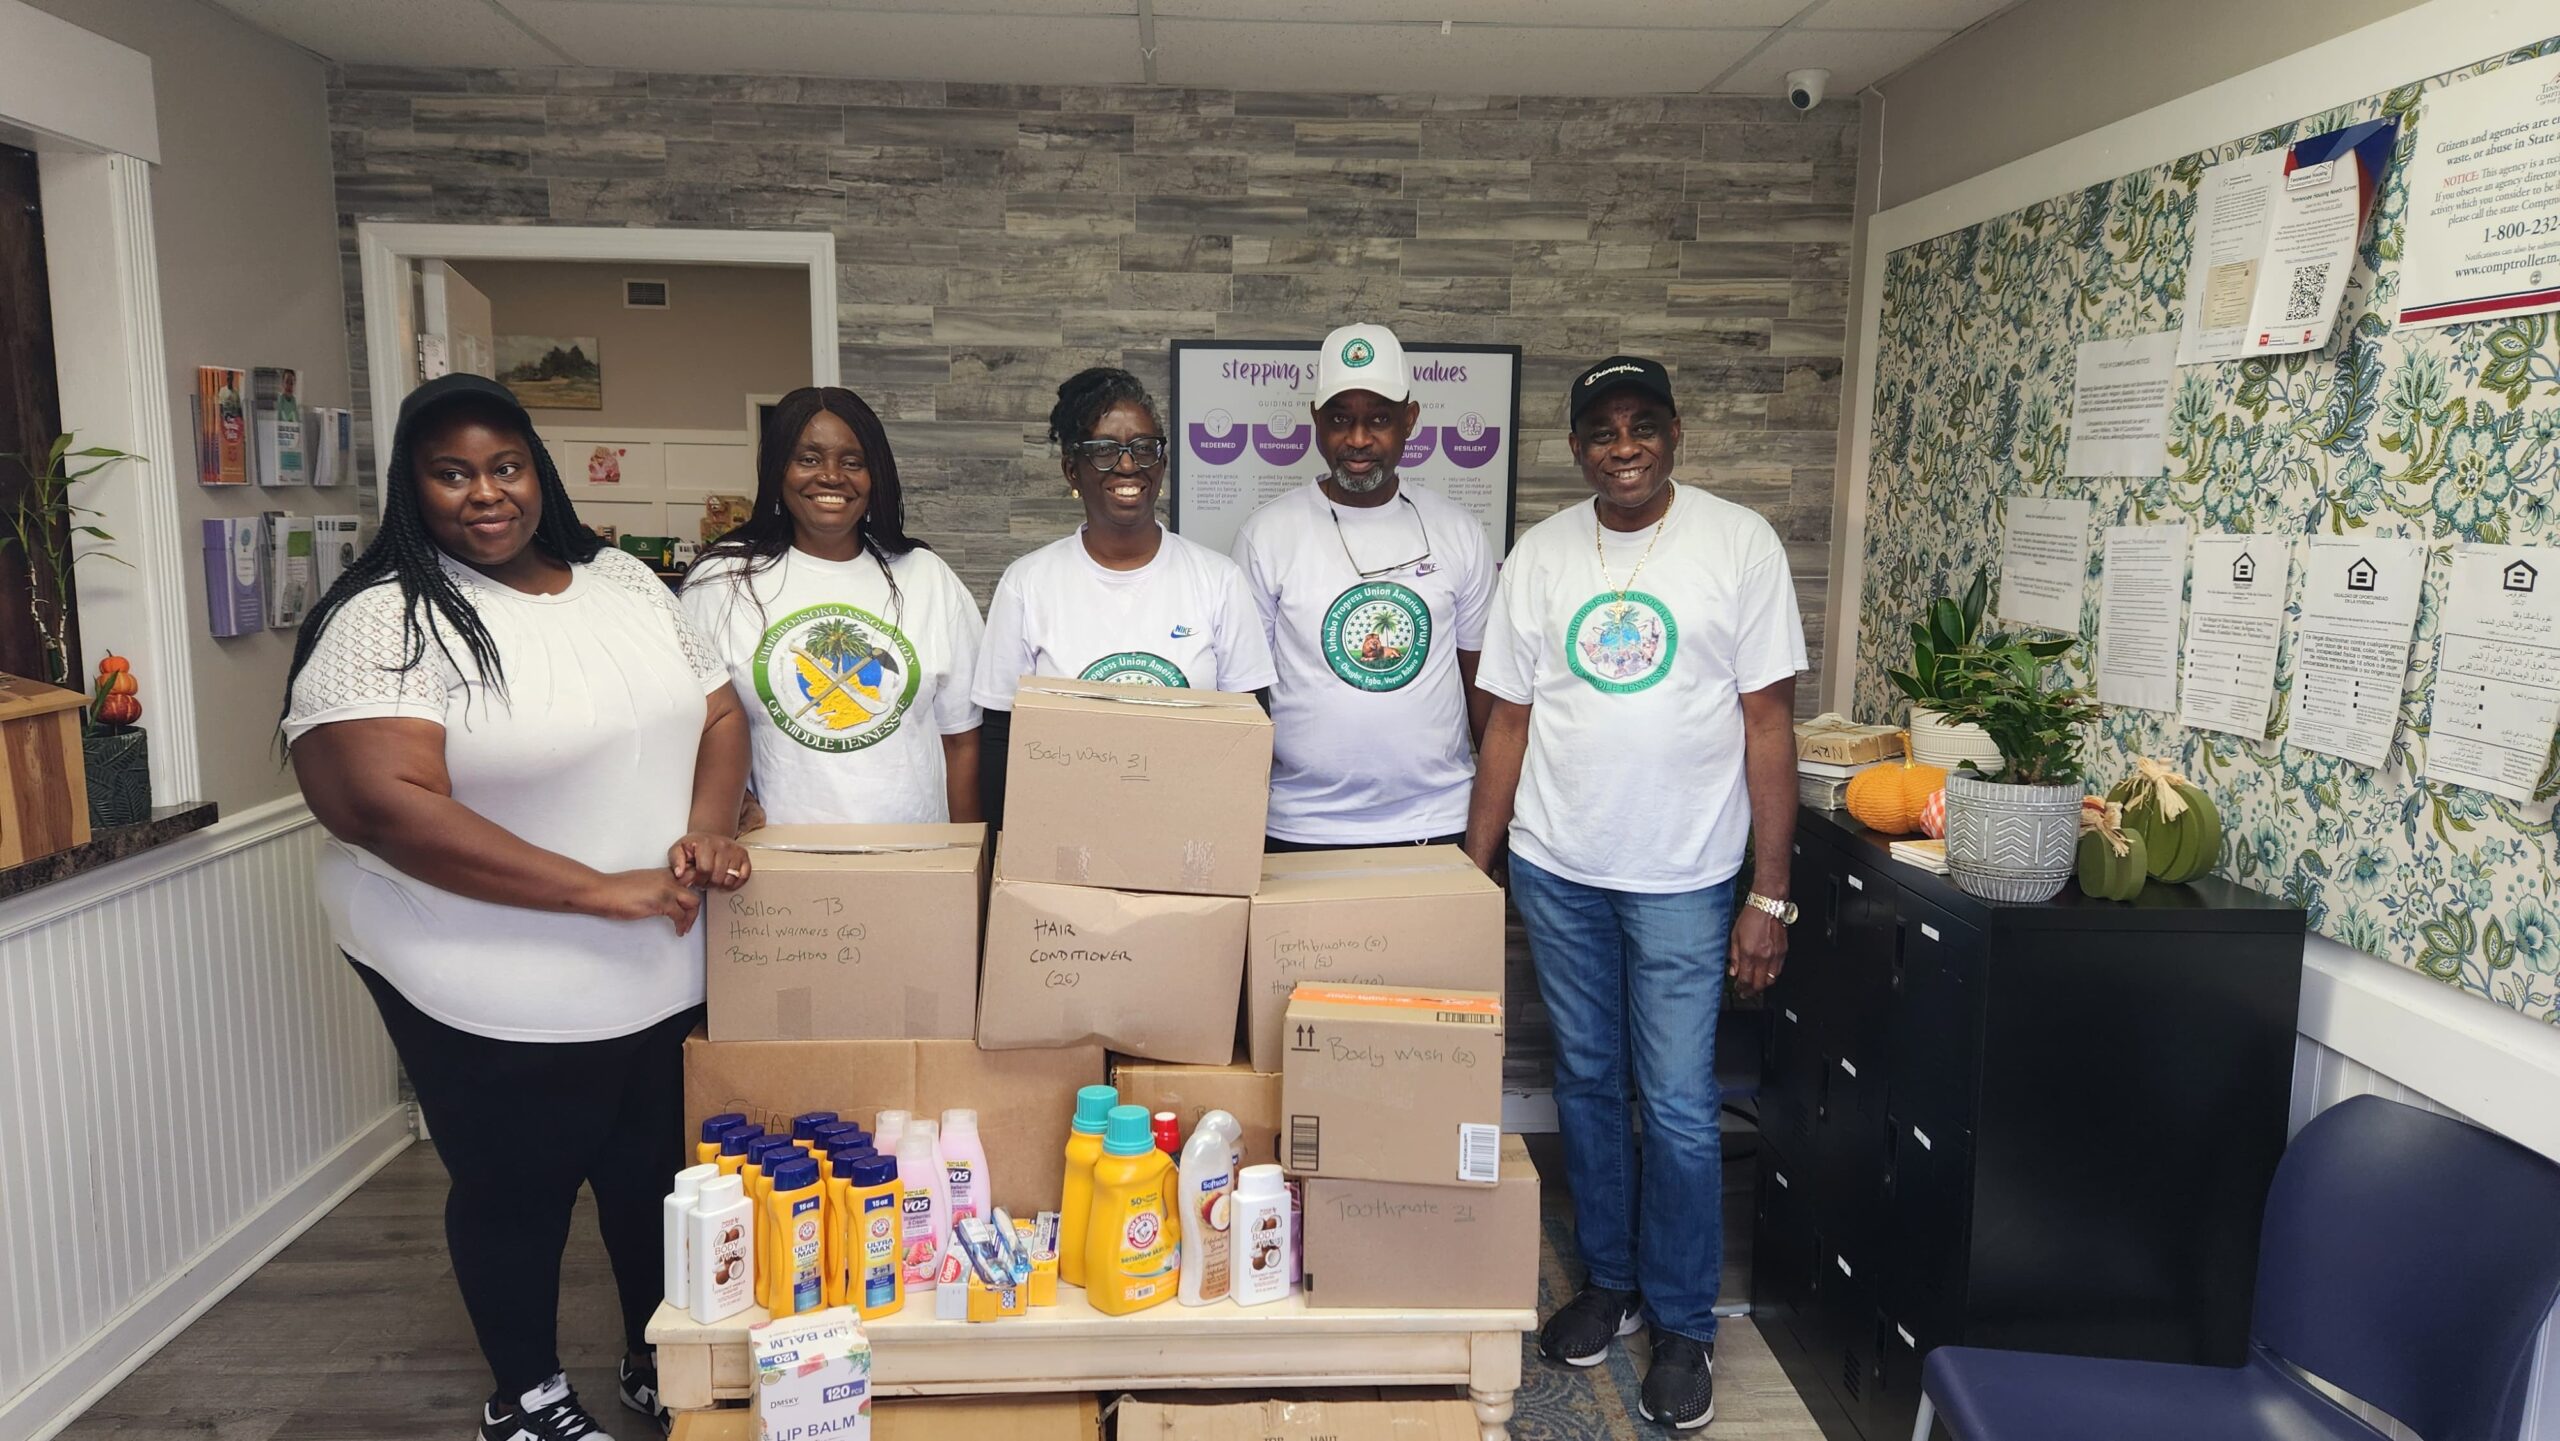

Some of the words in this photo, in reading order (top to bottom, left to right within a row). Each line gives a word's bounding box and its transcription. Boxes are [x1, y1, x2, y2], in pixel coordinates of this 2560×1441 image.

[2437, 138, 2469, 153] Citizens
[2470, 130, 2487, 145] and
[2489, 122, 2529, 142] agencies
[2532, 118, 2549, 130] are
[2473, 149, 2484, 159] or
[2485, 142, 2512, 156] abuse
[2514, 138, 2525, 149] in
[2527, 131, 2554, 146] State
[2481, 167, 2497, 179] This
[2499, 161, 2528, 177] agency
[2529, 158, 2537, 169] is
[2539, 158, 2544, 166] a
[2456, 185, 2482, 198] observe
[2484, 183, 2494, 191] an
[2495, 177, 2523, 191] agency
[2524, 169, 2556, 182] director
[2456, 197, 2478, 210] which
[2479, 195, 2493, 207] you
[2495, 187, 2531, 202] consider
[2532, 184, 2541, 195] to
[2543, 182, 2553, 193] be
[2448, 213, 2470, 228] please
[2471, 207, 2485, 220] call
[2485, 205, 2499, 217] the
[2500, 203, 2519, 215] state
[1222, 359, 1300, 390] stepping
[1413, 360, 1468, 382] values
[1585, 364, 1644, 386] Champion
[1258, 400, 1293, 408] GUIDING
[1200, 441, 1237, 449] REDEEMED
[1259, 442, 1305, 450] RESPONSIBLE
[1419, 562, 1437, 571] NIKE
[1364, 587, 1391, 596] Union
[1392, 588, 1422, 615] America
[1332, 592, 1363, 620] Progress
[1628, 593, 1674, 639] ASSOCIATION
[844, 610, 916, 666] ASSOCIATION
[1175, 624, 1193, 636] NIKE
[1327, 620, 1339, 652] Urhobo
[1416, 615, 1428, 647] (UPUA)
[1119, 657, 1147, 667] Union
[1148, 659, 1180, 687] America
[1570, 661, 1580, 676] OF
[1582, 672, 1618, 692] MIDDLE
[1621, 660, 1671, 692] TENNESSEE
[768, 699, 785, 720] OF
[780, 718, 835, 750] MIDDLE
[837, 698, 909, 750] TENNESSEE
[1024, 741, 1071, 766] Body
[1075, 746, 1119, 765] Wash
[1127, 752, 1147, 772] 31
[729, 893, 792, 917] Rollon
[729, 919, 770, 939] Hand
[1034, 918, 1076, 941] HAIR
[725, 945, 768, 965] Body
[837, 946, 861, 964] (1)
[1266, 931, 1360, 959] Toothbrushes
[1030, 949, 1132, 963] CONDITIONER
[1045, 970, 1080, 988] (26)
[1272, 979, 1297, 995] Han
[1327, 1037, 1384, 1067] Body
[1394, 1046, 1443, 1062] Wash
[799, 1203, 806, 1211] 15
[806, 1201, 814, 1209] oz
[880, 1198, 888, 1206] oz
[903, 1199, 929, 1212] VO5
[1326, 1194, 1440, 1221] Toothpaste
[866, 1238, 893, 1249] ULTRA
[1253, 1230, 1276, 1241] BODY
[714, 1241, 739, 1256] BODY
[794, 1240, 819, 1253] ULTRA
[797, 1248, 817, 1259] MAX
[870, 1244, 891, 1254] MAX
[1120, 1249, 1152, 1264] sensitive
[1152, 1246, 1165, 1256] skin
[770, 1331, 819, 1350] BALM
[823, 1325, 849, 1340] LIP
[773, 1351, 798, 1364] 120
[826, 1385, 851, 1399] 120
[851, 1387, 864, 1396] PCS
[770, 1396, 799, 1409] DMSKY
[777, 1427, 802, 1441] LIP
[808, 1414, 855, 1437] BALM
